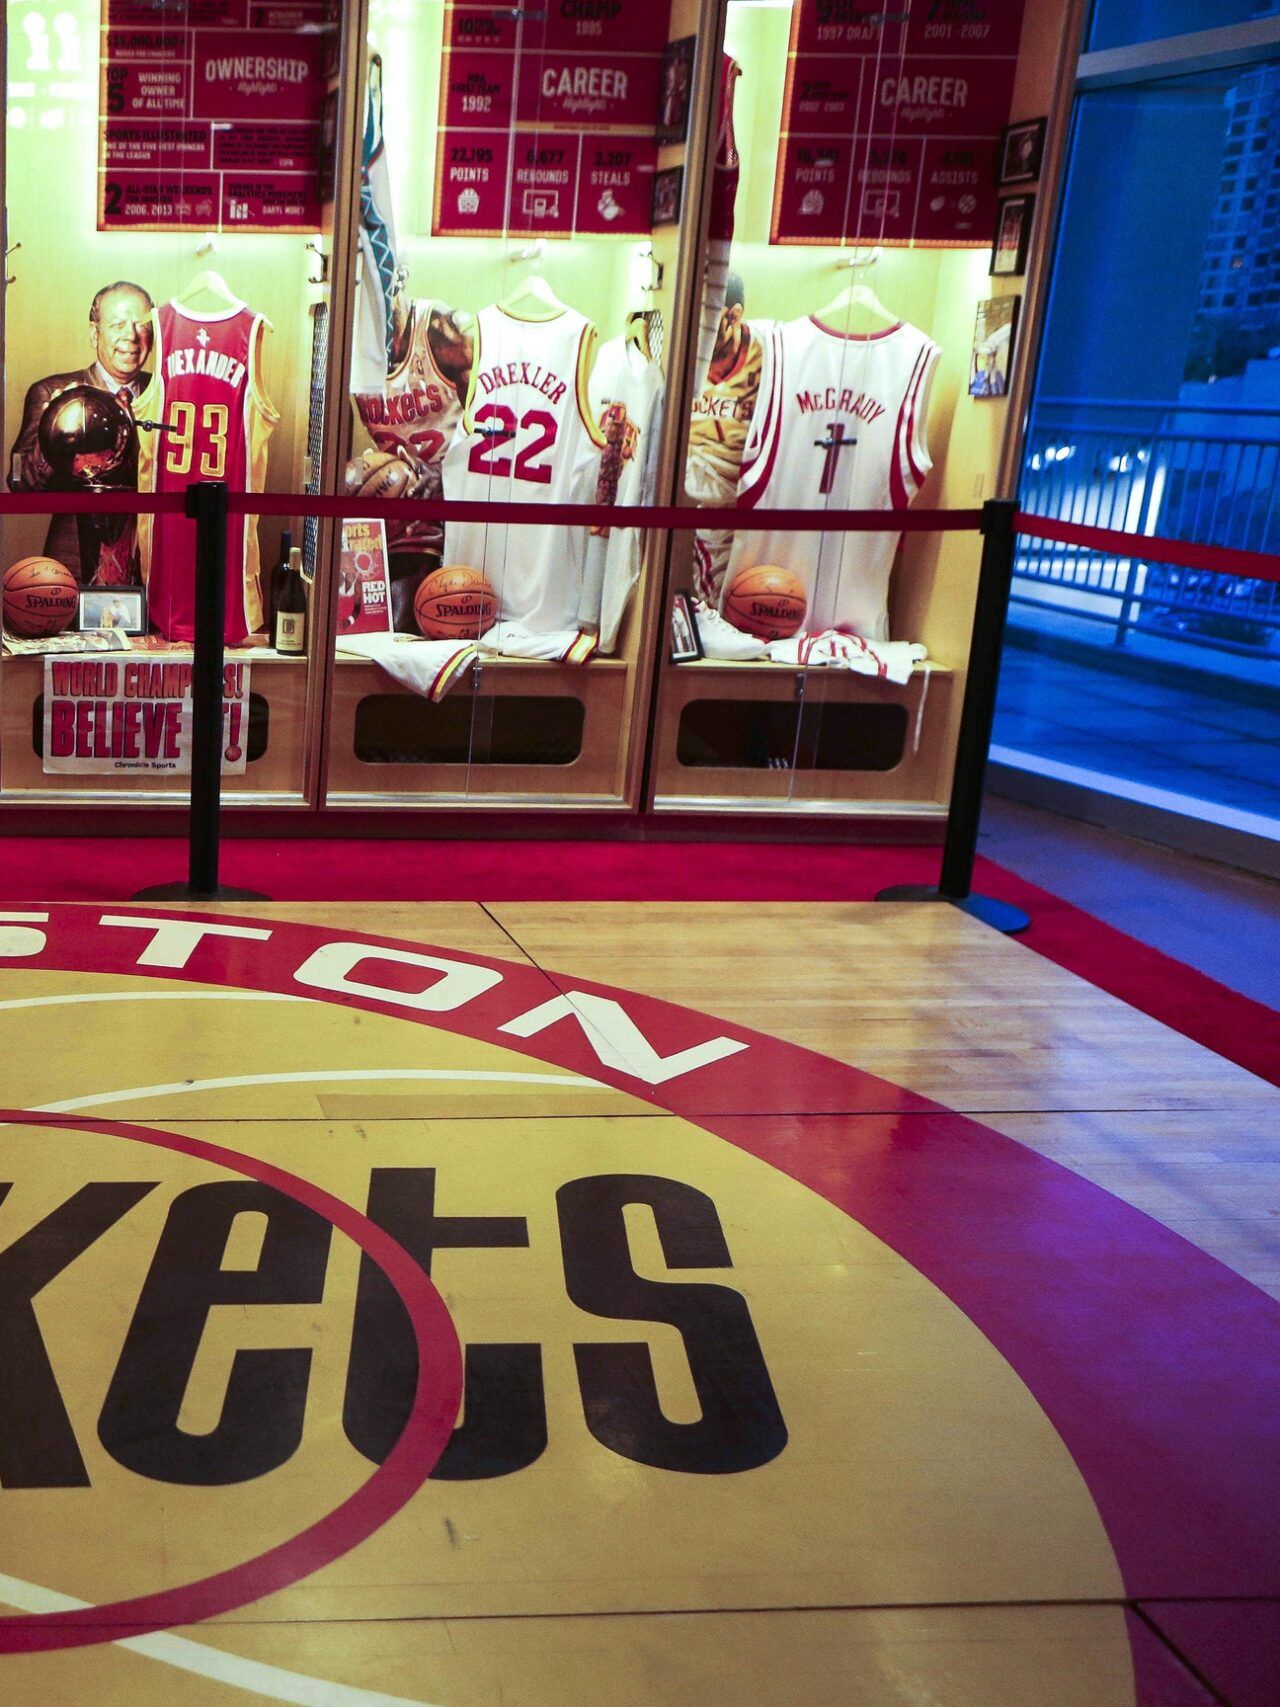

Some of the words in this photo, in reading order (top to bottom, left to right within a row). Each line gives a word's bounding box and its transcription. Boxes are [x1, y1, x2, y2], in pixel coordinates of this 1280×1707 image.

[205, 55, 309, 83] OWNERSHIP
[138, 72, 181, 84] WINNING
[542, 66, 628, 100] CAREER
[140, 85, 176, 97] OWNER
[880, 76, 968, 107] CAREER
[132, 98, 144, 110] OF
[146, 98, 161, 110] ALL
[163, 97, 185, 110] TIME
[449, 167, 490, 183] POINTS
[516, 168, 569, 185] REBOUNDS
[590, 170, 631, 186] STEALS
[794, 168, 836, 184] POINTS
[857, 168, 912, 184] REBOUNDS
[930, 169, 980, 185] ASSISTS
[105, 182, 122, 215] 2
[477, 362, 568, 406] DREXLER
[796, 387, 886, 424] McGRADY
[166, 401, 229, 477] 93
[468, 403, 559, 484] 22
[819, 422, 846, 494] 1
[361, 580, 386, 593] RED
[26, 594, 78, 609] SPALDING
[363, 592, 386, 605] HOT
[435, 602, 492, 618] SPALDING
[51, 661, 119, 698] WORLD
[123, 662, 245, 699] CHAMPS!
[50, 699, 184, 760] BELIEVE
[151, 761, 177, 770] Sports
